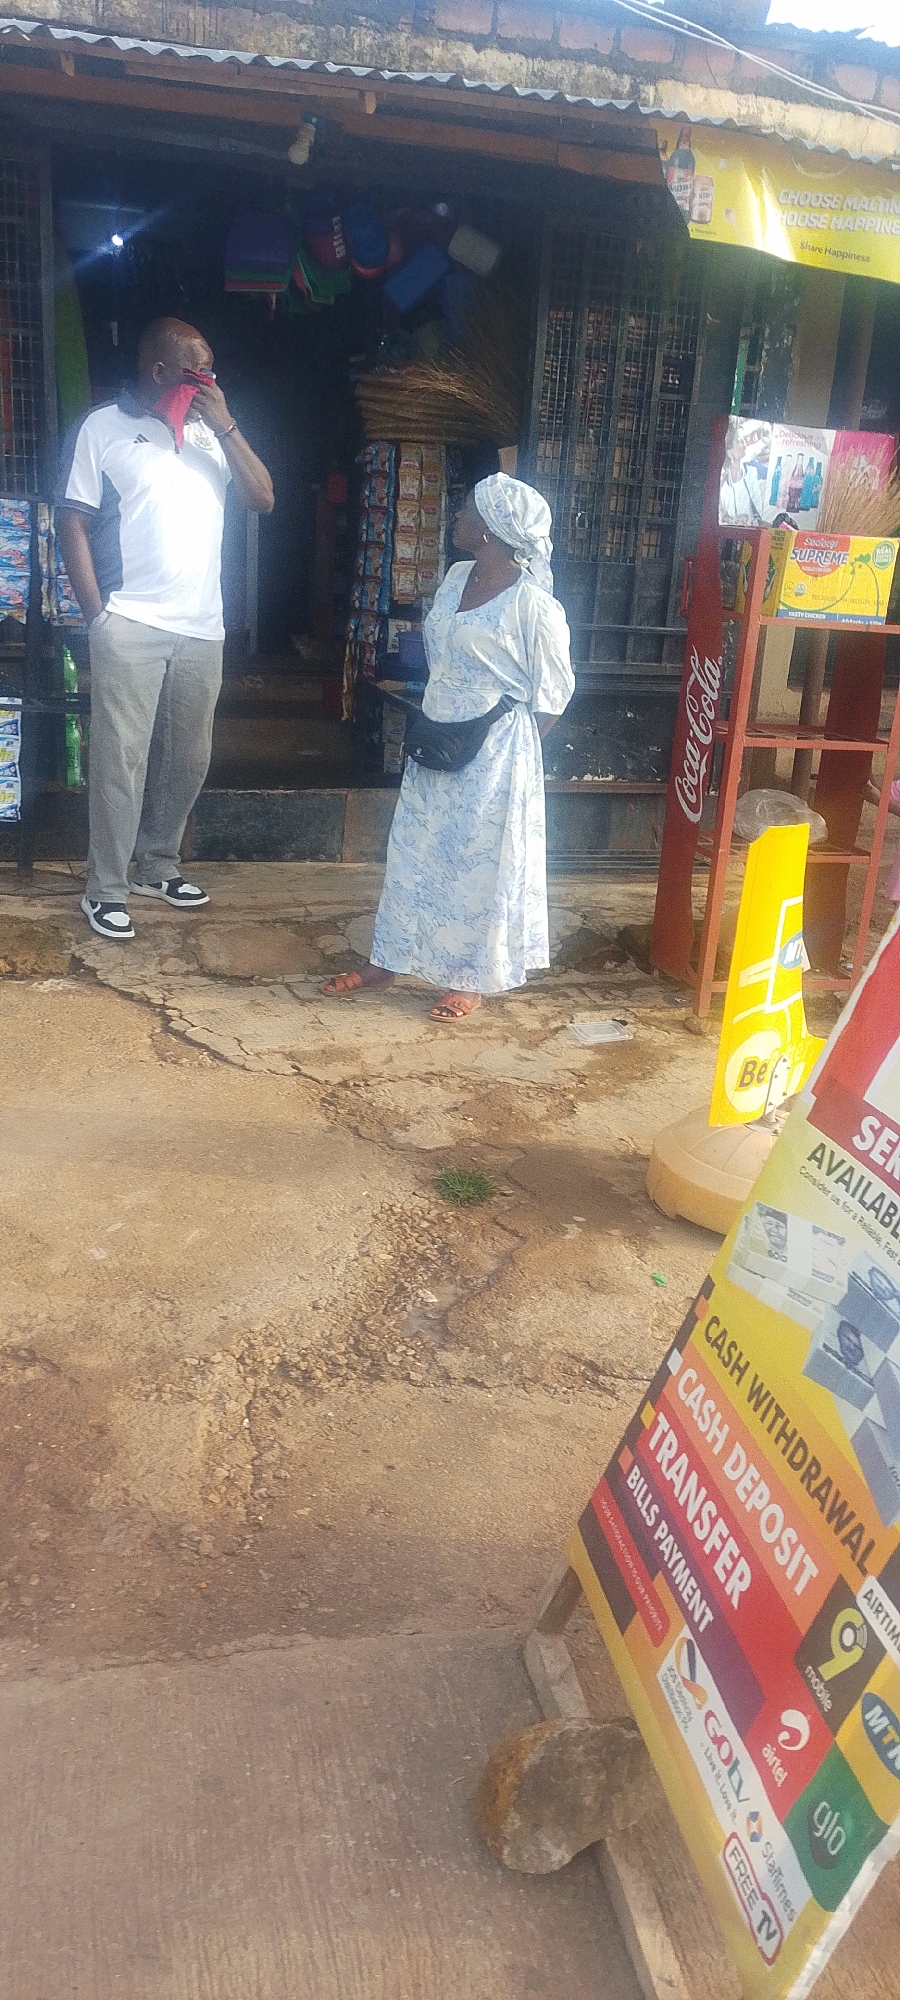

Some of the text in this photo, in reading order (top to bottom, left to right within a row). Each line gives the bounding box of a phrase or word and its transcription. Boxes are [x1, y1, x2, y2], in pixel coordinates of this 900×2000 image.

[778, 189, 841, 210] CHOOSE
[778, 211, 829, 230] HOOSE
[800, 241, 871, 263] Share Happiness
[790, 547, 850, 568] SUPREME
[799, 1165, 832, 1197] Consider
[831, 1194, 841, 1206] us
[841, 1201, 853, 1215] for
[703, 1315, 878, 1578] CASH WITHDRAWAL
[677, 1368, 820, 1596] CASH DEPOSIT
[648, 1412, 752, 1611] TRANSFER
[626, 1464, 715, 1633] BILLS PAYMENT
[804, 1665, 834, 1714] mobile
[762, 1742, 789, 1788] airtel
[813, 1800, 846, 1856] glo
[728, 1845, 778, 1942] FREE TV
